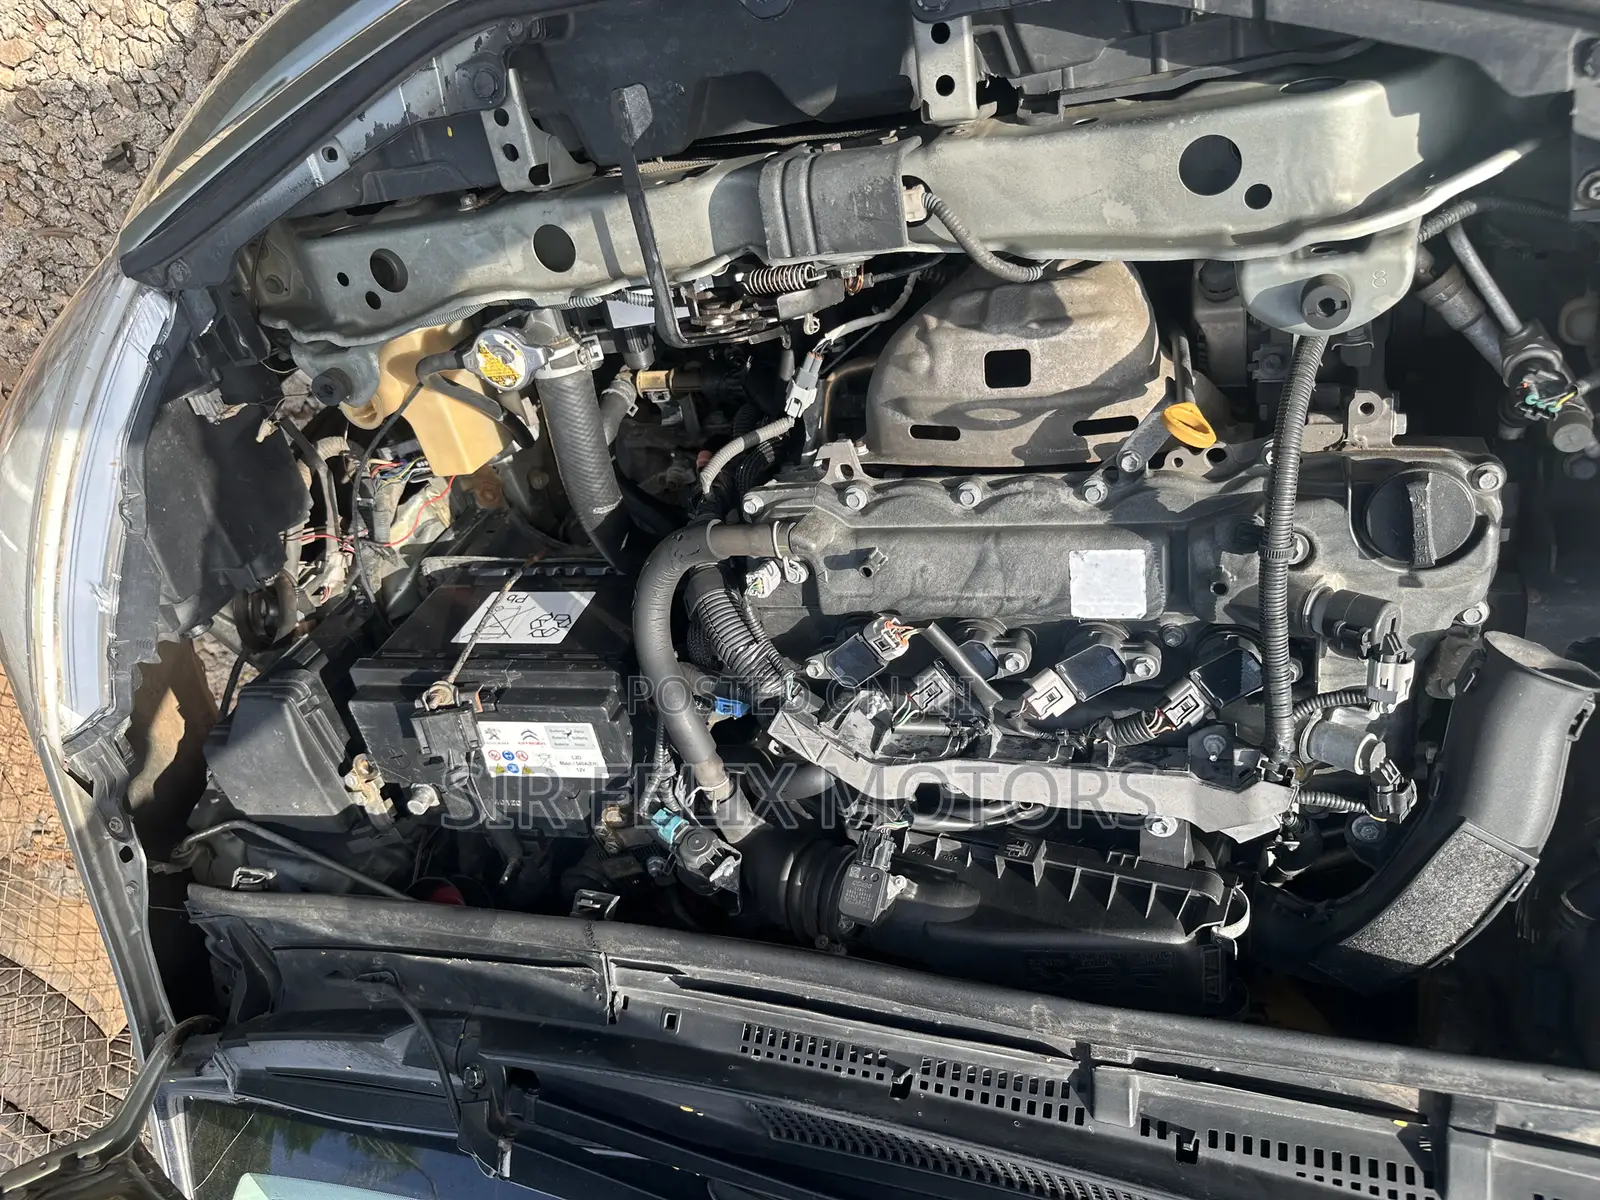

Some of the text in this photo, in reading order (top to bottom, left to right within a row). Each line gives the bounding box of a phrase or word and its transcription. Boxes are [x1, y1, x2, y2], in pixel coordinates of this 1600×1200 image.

[1415, 512, 1427, 563] ENGINE OIL
[506, 594, 530, 603] Pb
